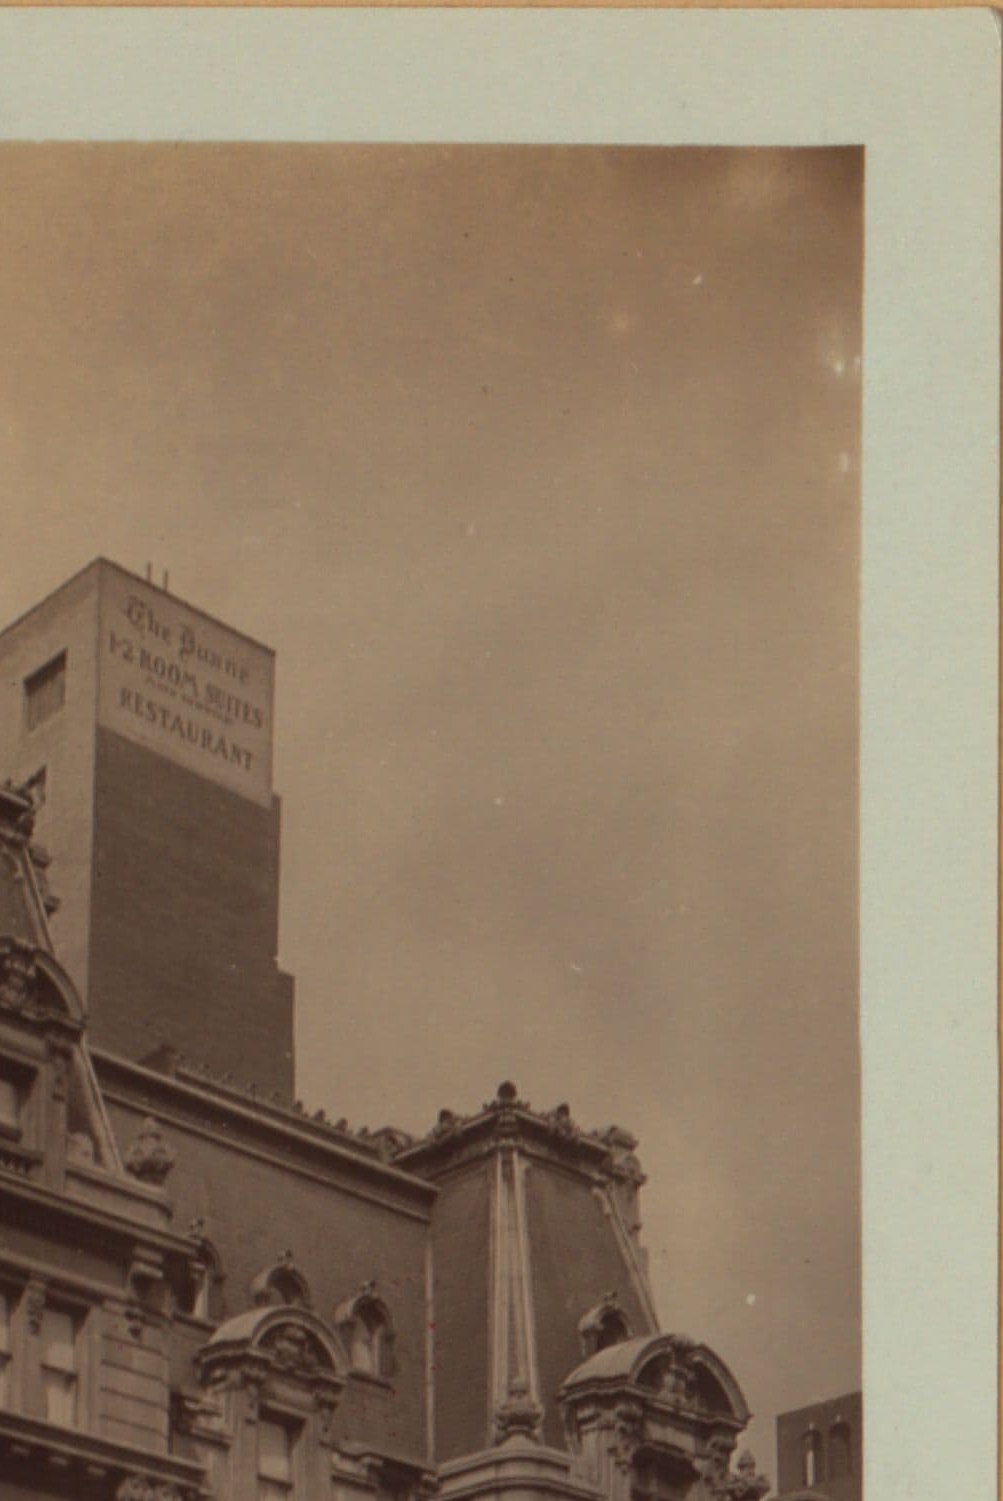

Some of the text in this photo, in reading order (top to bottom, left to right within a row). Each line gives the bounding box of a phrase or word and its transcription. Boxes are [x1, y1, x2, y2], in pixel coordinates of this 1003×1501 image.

[122, 595, 171, 646] The
[120, 686, 253, 771] RESTAURANT
[139, 647, 199, 698] ROOM
[205, 682, 263, 729] SUITES
